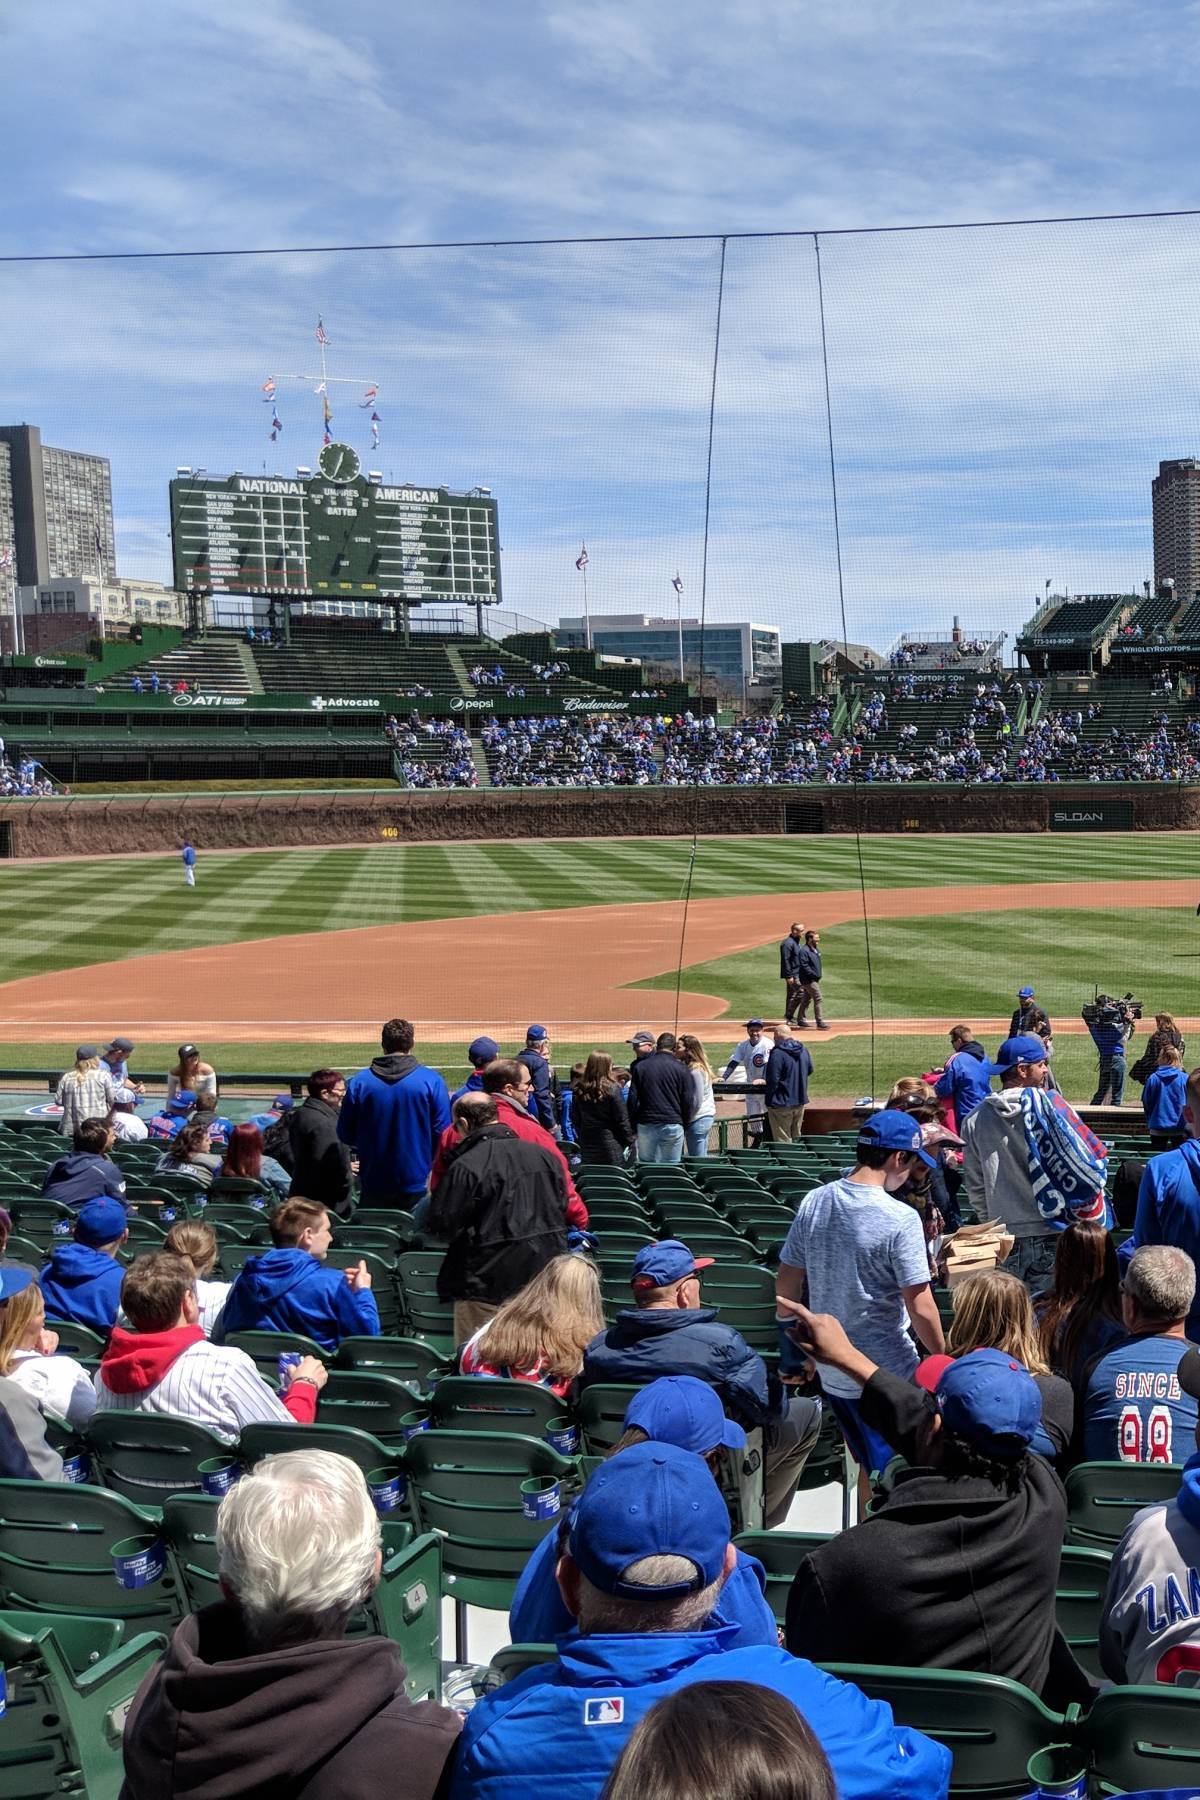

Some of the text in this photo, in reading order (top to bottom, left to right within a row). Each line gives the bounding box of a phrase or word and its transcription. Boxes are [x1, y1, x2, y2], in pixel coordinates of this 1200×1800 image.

[240, 479, 307, 495] NATIONAL
[323, 488, 359, 498] UMPIRES
[375, 488, 439, 503] AMERICAN
[327, 507, 357, 517] BATTER
[192, 696, 222, 706] ATI
[328, 698, 380, 707] Advocate
[465, 698, 494, 709] pepsi
[563, 698, 630, 711] Budweiser
[1054, 813, 1103, 822] SLOAN
[382, 828, 398, 837] 400
[1116, 1372, 1182, 1400] SINCE
[1118, 1406, 1173, 1464] 98
